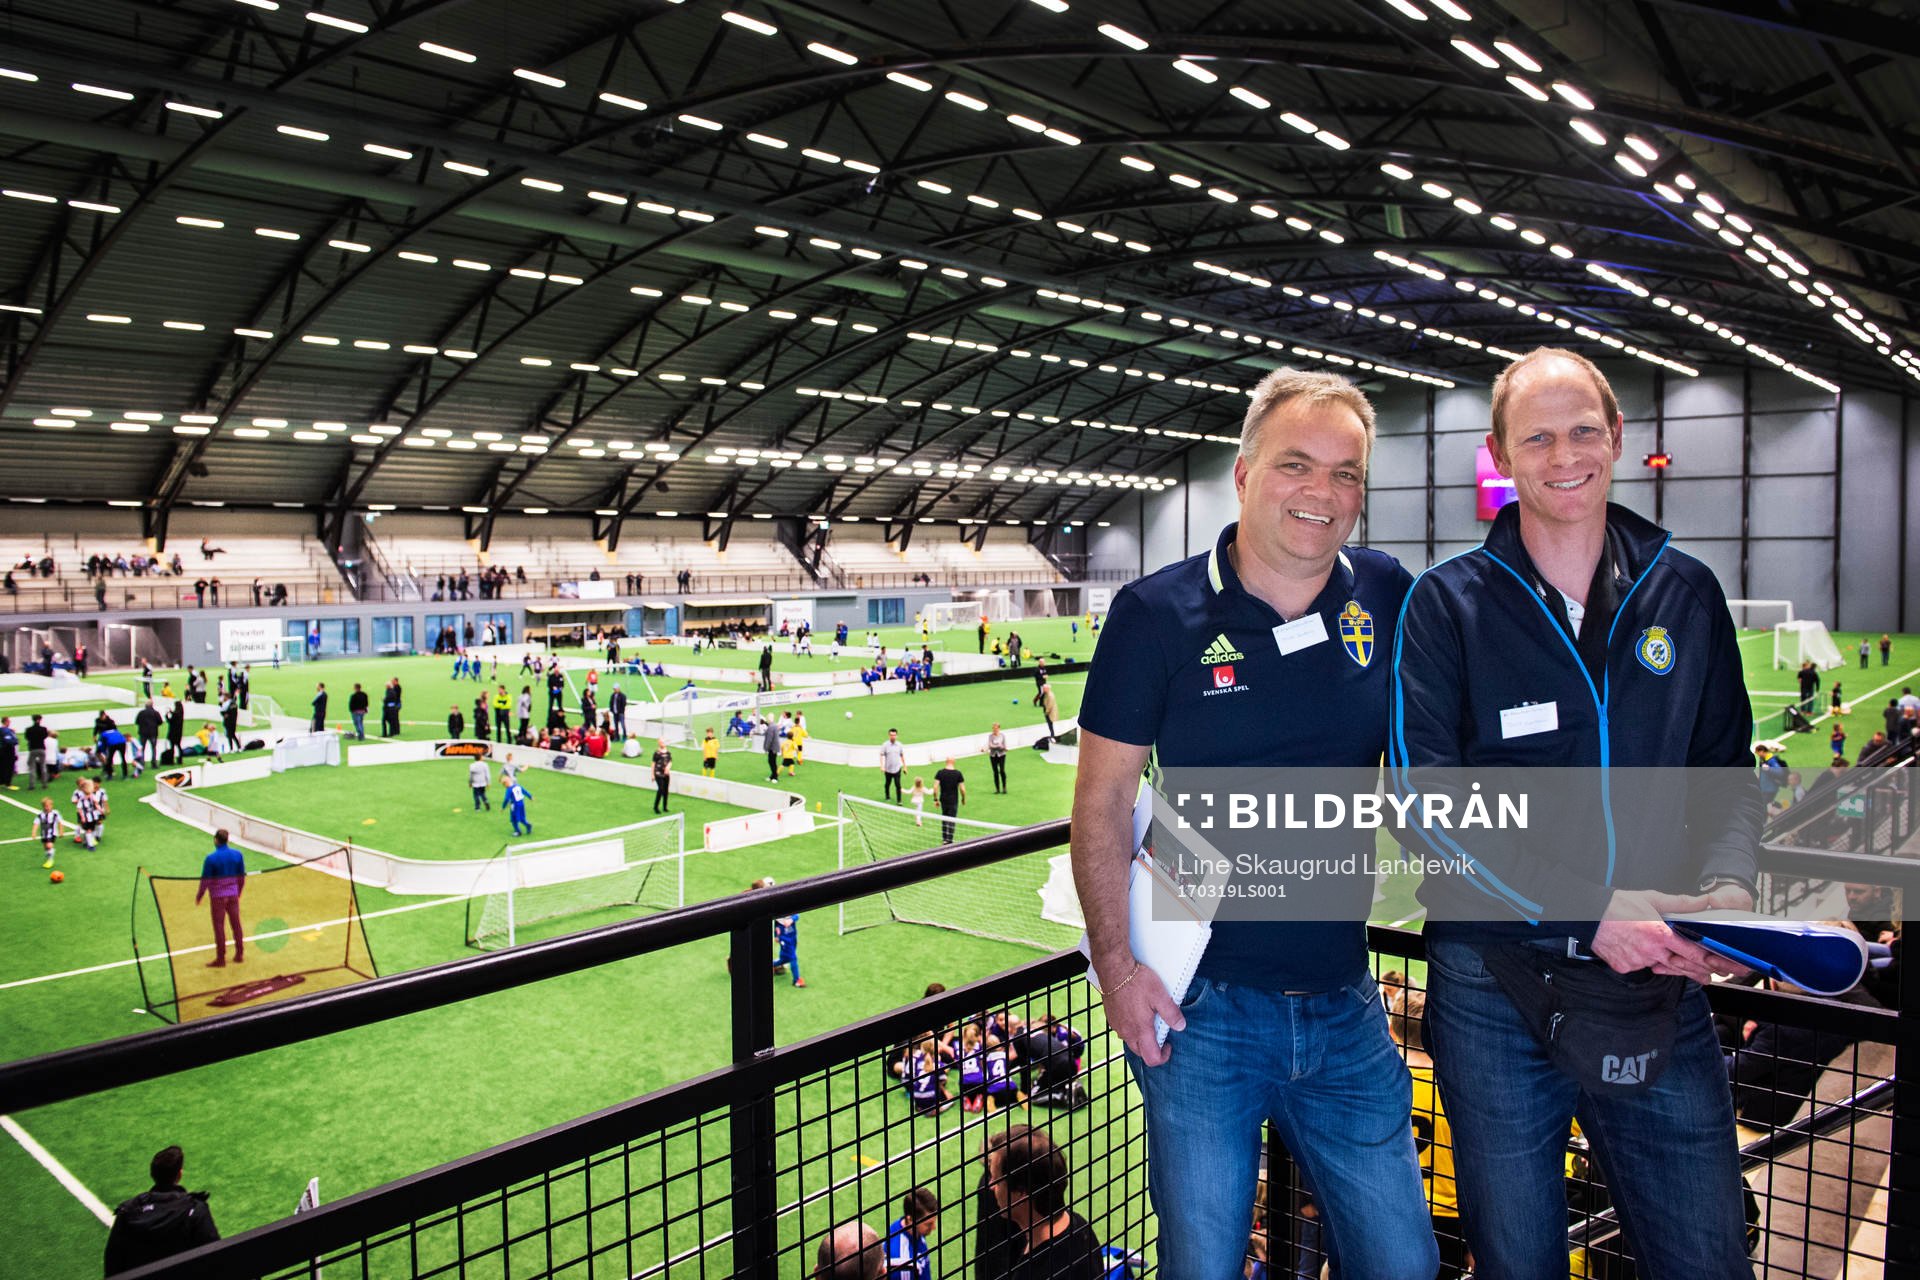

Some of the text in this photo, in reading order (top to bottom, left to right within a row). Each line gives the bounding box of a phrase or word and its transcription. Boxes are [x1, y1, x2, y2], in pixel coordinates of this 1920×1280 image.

[1200, 651, 1245, 665] adidas
[1203, 687, 1233, 696] SVENSKA
[1602, 1052, 1650, 1084] CAT
